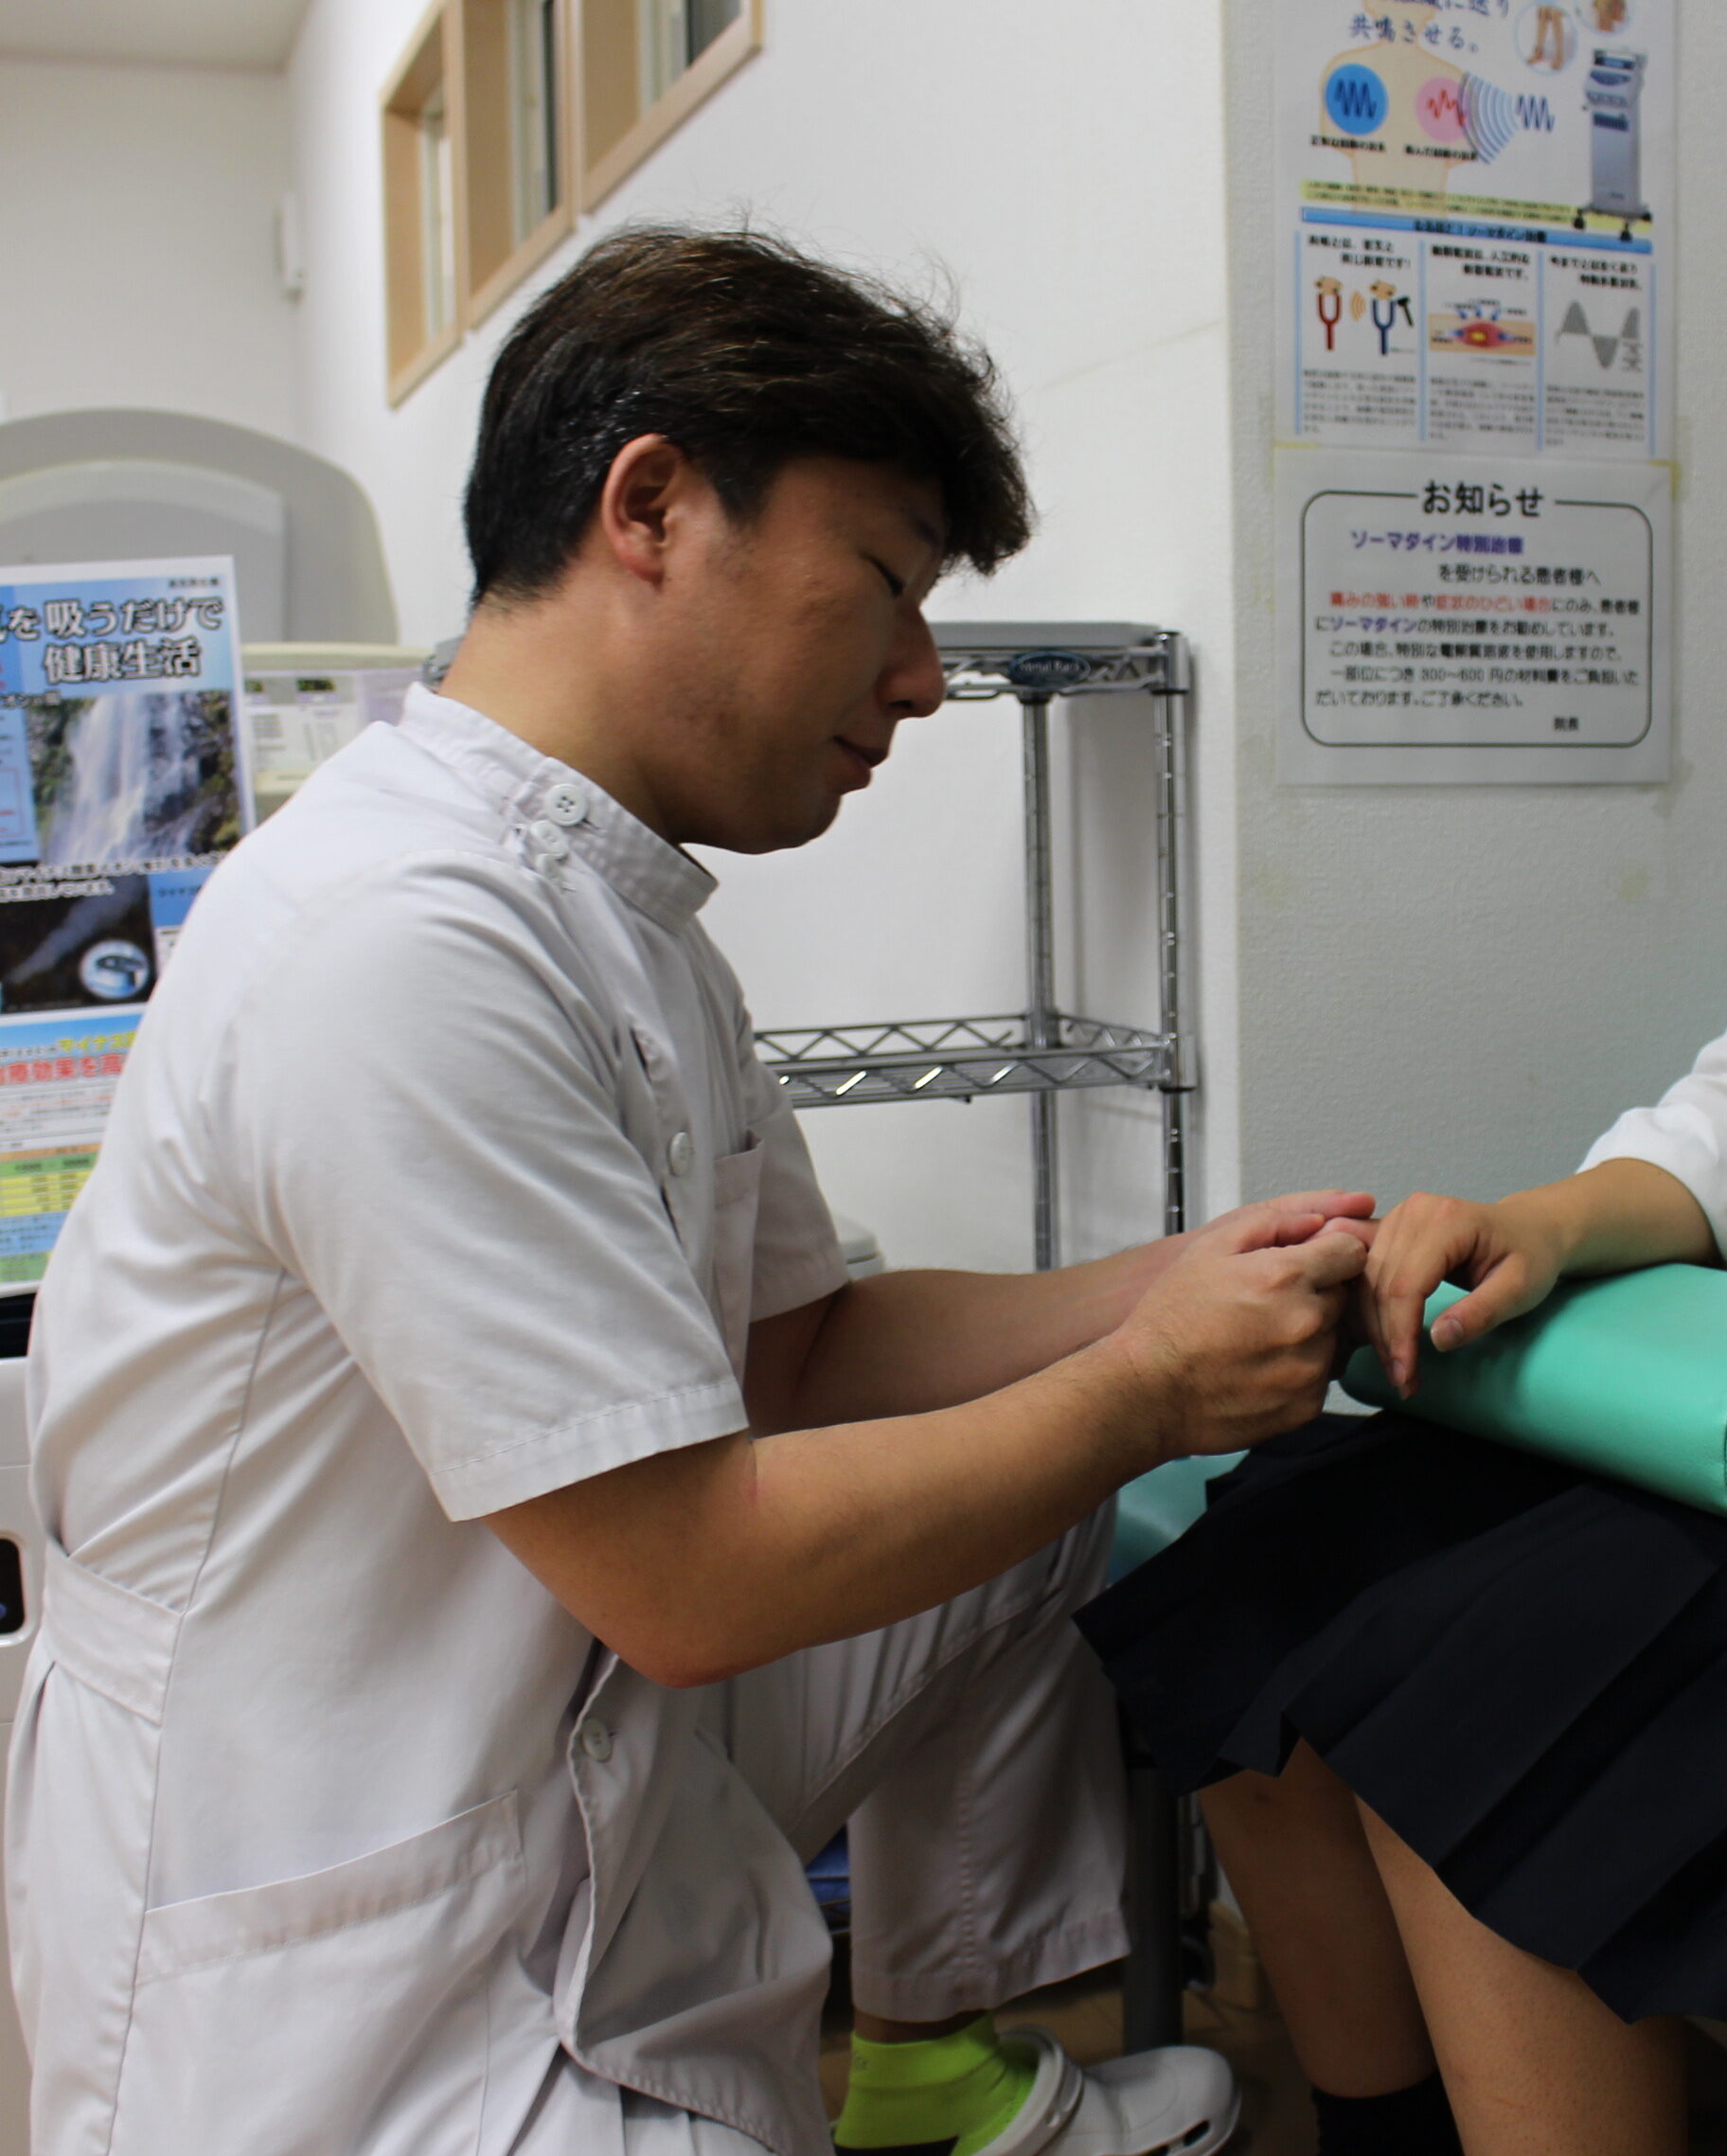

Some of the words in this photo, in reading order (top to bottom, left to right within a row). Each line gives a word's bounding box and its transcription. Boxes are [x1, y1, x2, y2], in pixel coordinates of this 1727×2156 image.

[1350, 13, 1479, 53] 共鳴させる。
[1422, 480, 1545, 518] お知らせ
[0, 596, 224, 644] を吸うだけで
[44, 635, 202, 685] 健康生活
